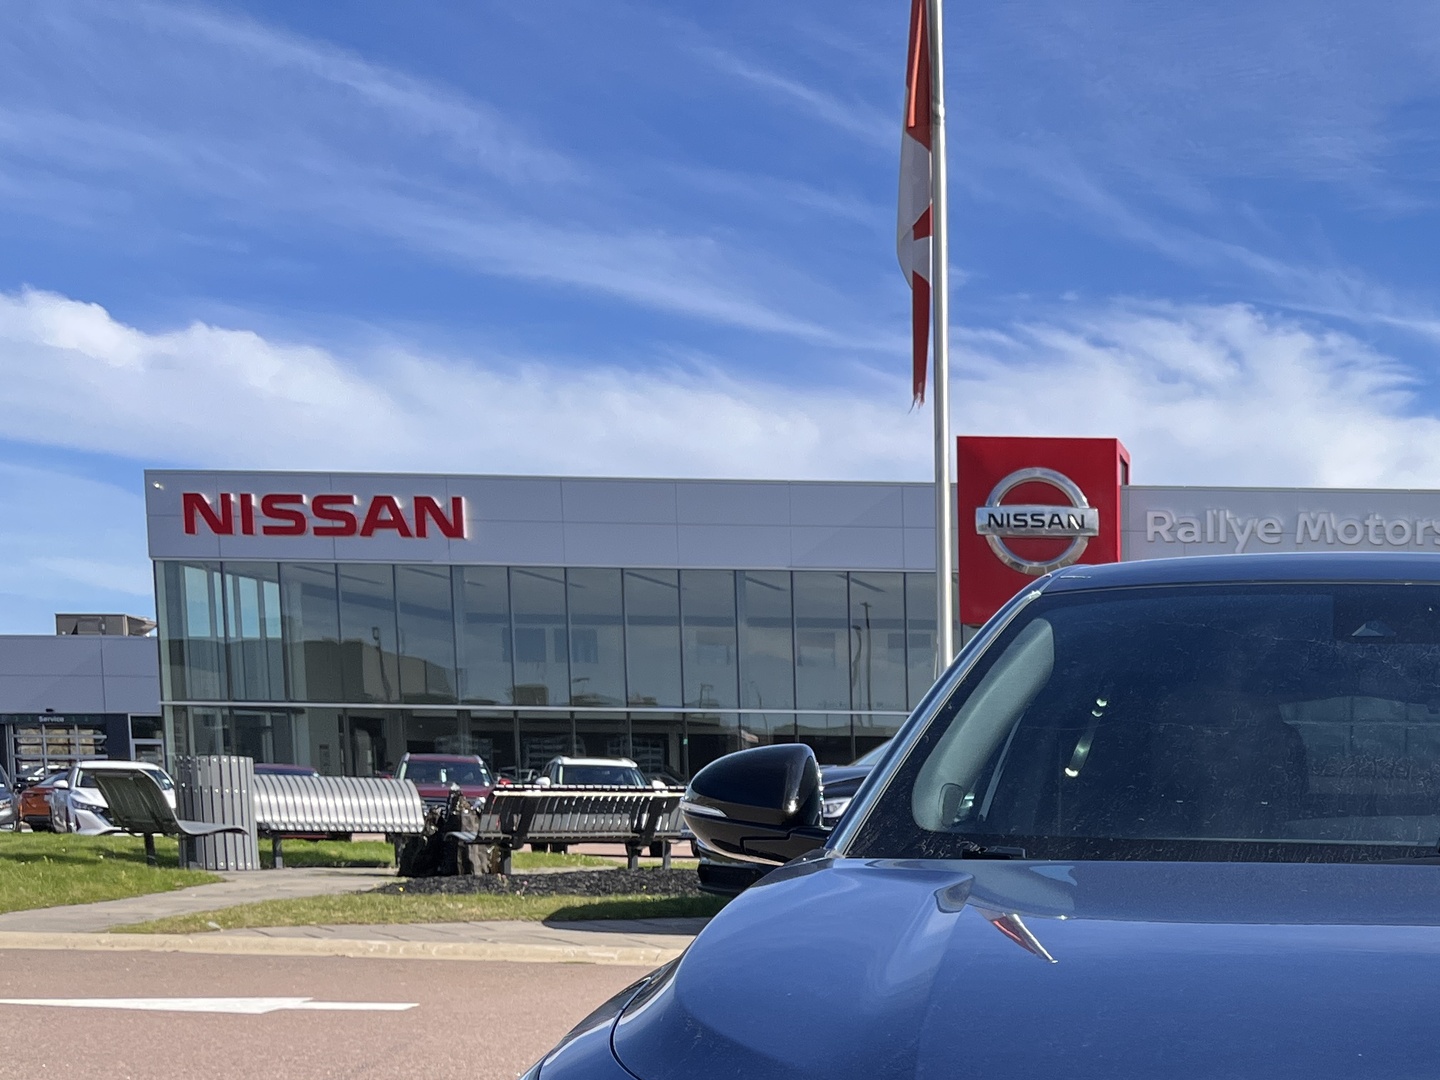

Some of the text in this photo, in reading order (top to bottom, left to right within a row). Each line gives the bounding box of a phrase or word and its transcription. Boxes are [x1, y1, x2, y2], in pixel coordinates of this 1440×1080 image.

[182, 493, 467, 539] NISSAN
[988, 513, 1085, 529] NISSAN
[1146, 509, 1282, 553] Rallye
[39, 715, 65, 723] Service
